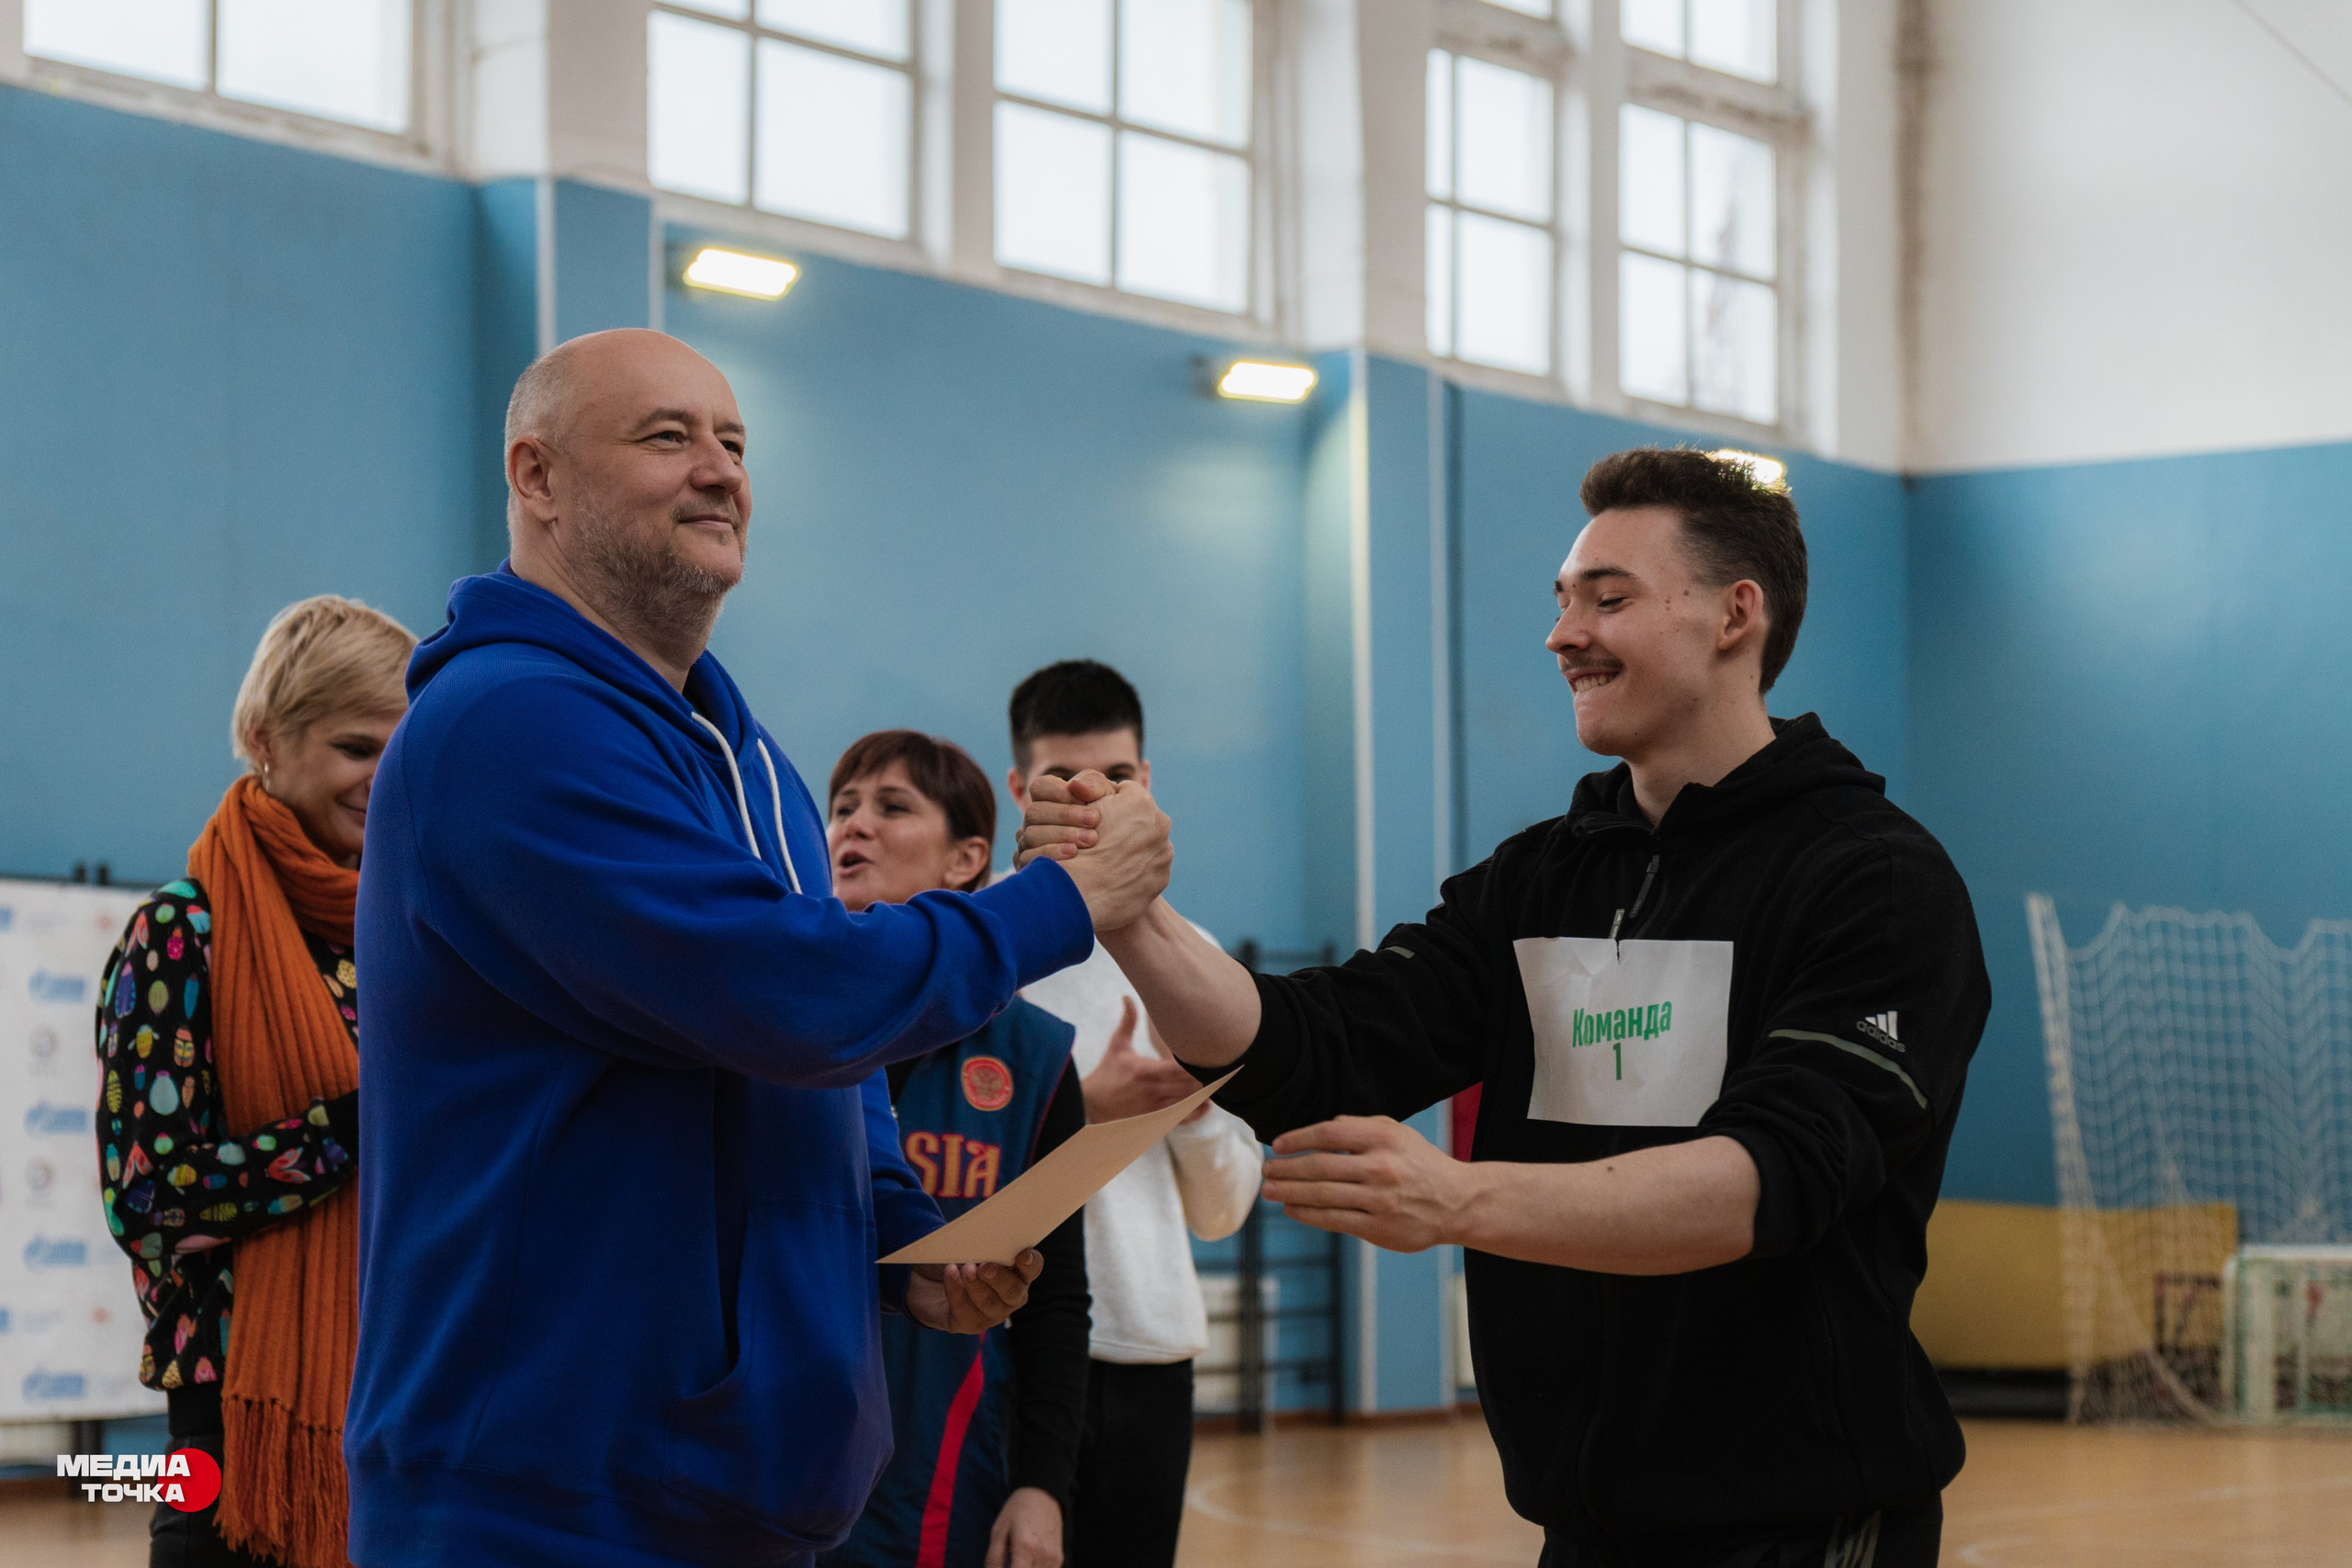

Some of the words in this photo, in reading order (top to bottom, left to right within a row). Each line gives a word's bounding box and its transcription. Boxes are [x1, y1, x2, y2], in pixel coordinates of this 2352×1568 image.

[1572, 1001, 1672, 1047] Команда
[1857, 1021, 1906, 1053] adidas
[1612, 1043, 1623, 1081] 1
